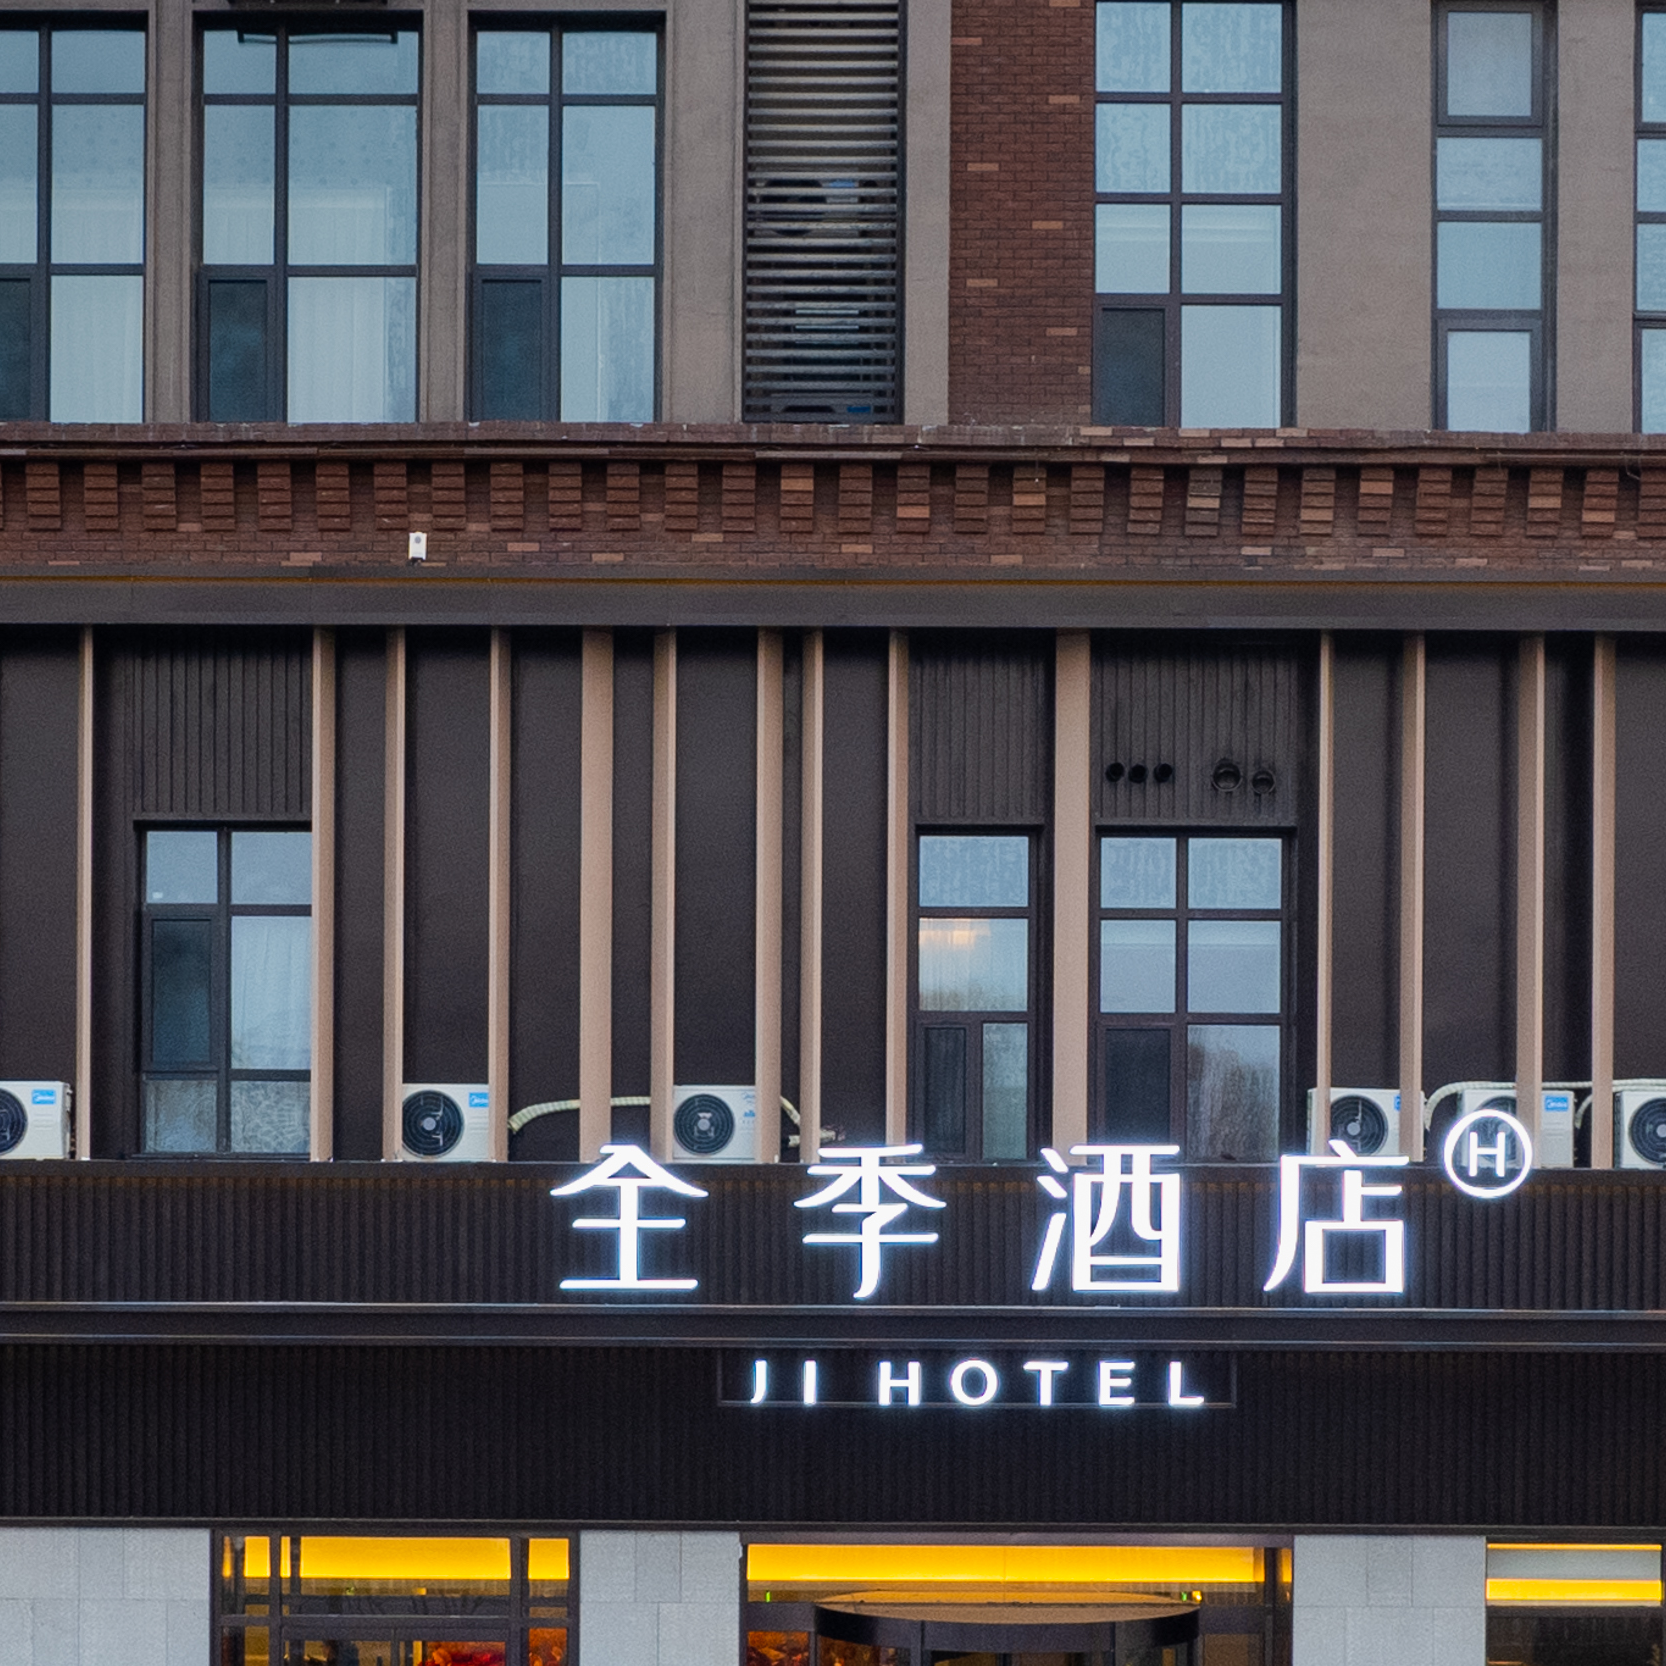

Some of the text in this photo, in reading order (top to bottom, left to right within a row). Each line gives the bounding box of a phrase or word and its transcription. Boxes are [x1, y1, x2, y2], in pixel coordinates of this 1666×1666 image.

[550, 1140, 1410, 1298] 全季酒店
[750, 1360, 1205, 1406] JI HOTEL
